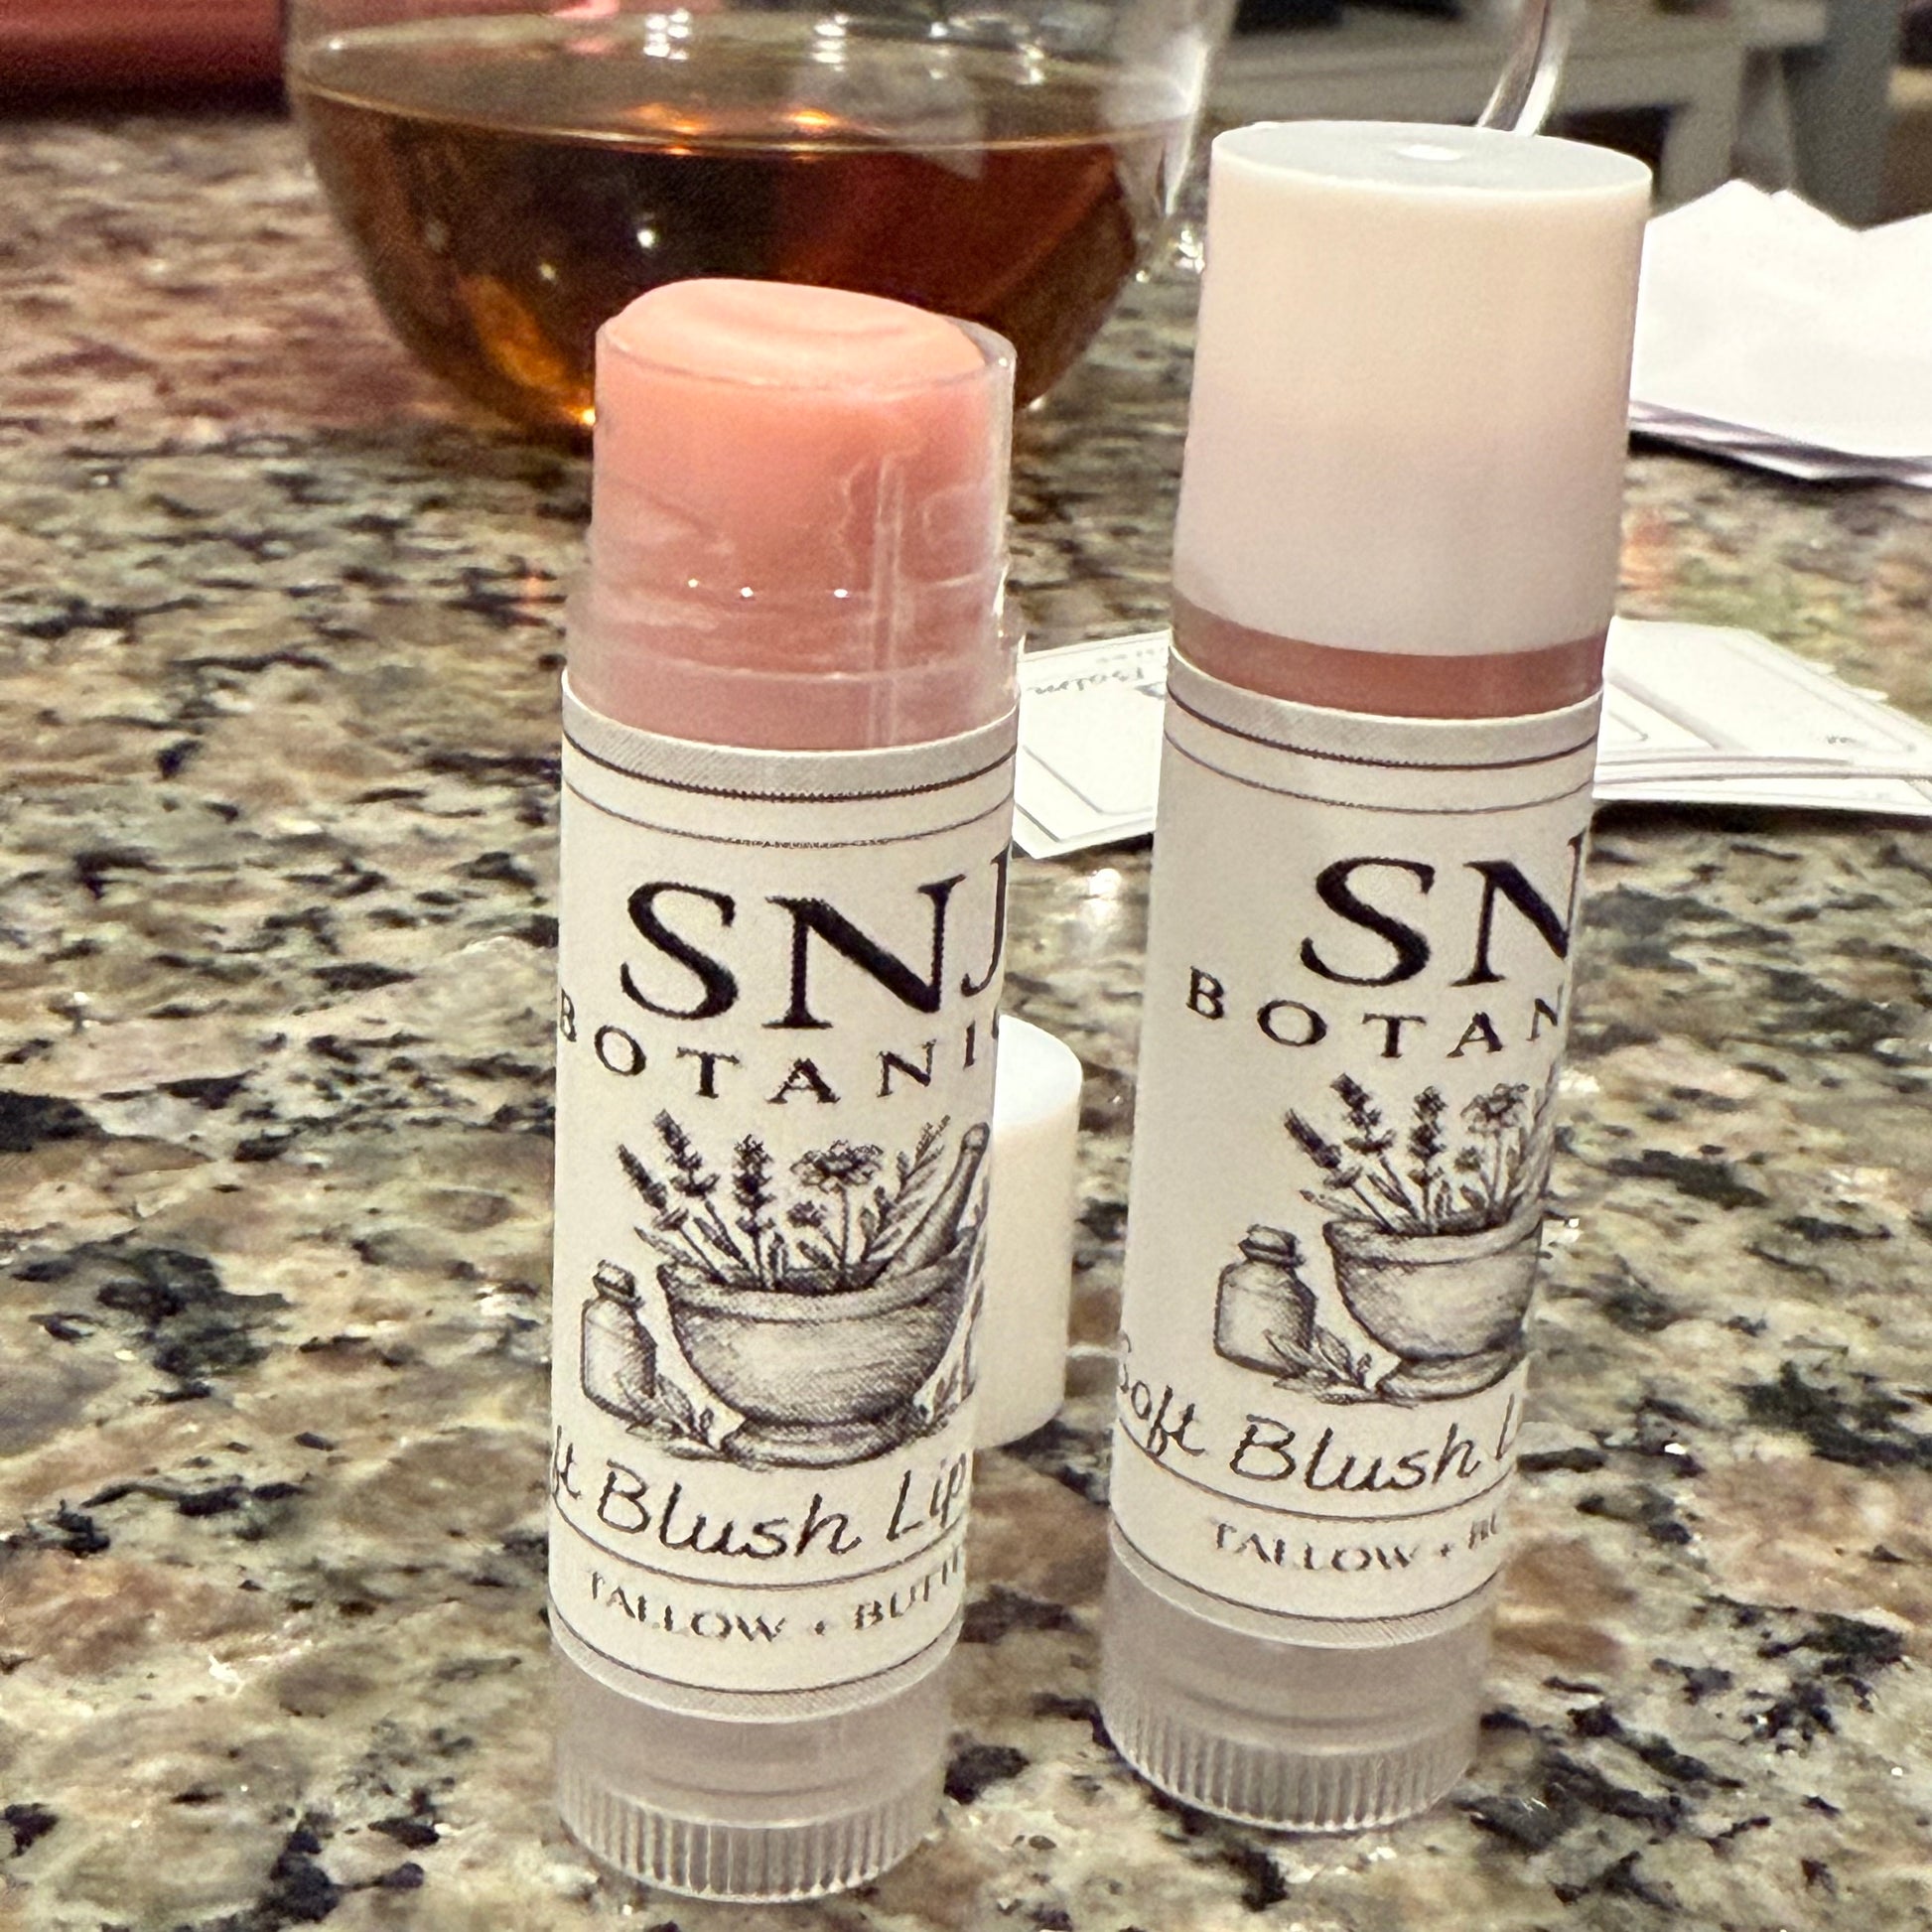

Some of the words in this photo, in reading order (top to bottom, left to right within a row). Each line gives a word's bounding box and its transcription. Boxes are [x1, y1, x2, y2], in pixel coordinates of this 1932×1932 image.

[620, 846, 1009, 1029] SNJ
[1229, 1414, 1481, 1492] Blush
[597, 1457, 863, 1559] Blush
[1213, 1521, 1420, 1572] TALLOW
[589, 1570, 787, 1642] TALLOW
